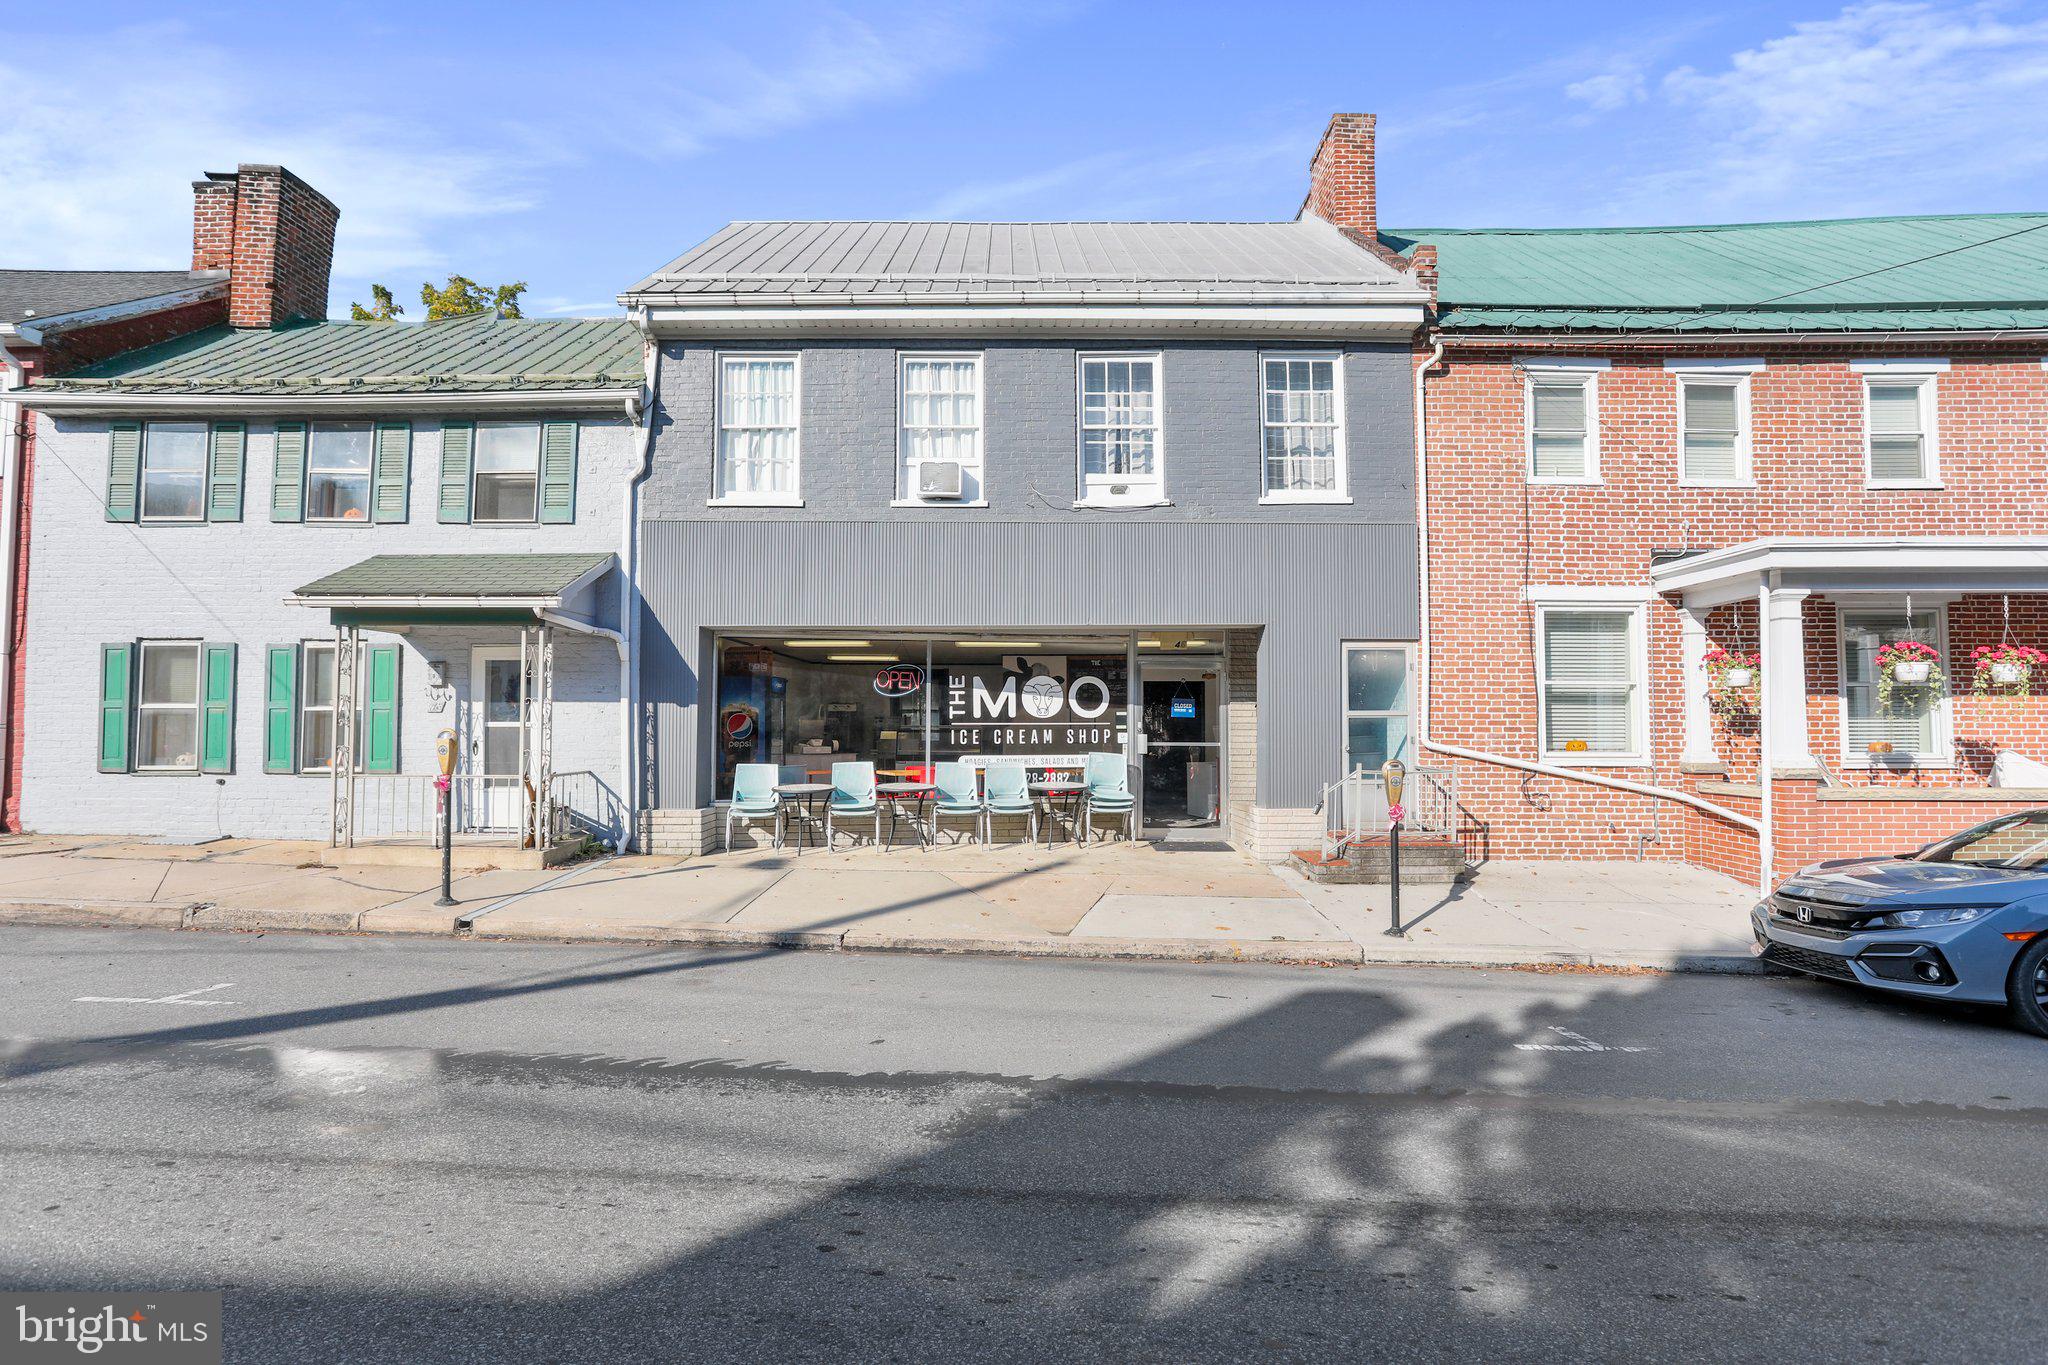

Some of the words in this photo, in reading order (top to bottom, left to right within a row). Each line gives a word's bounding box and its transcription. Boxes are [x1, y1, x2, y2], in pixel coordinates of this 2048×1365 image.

[876, 670, 920, 690] OPEN
[949, 675, 966, 720] THE
[728, 739, 752, 749] pepsi
[951, 729, 980, 745] ICE
[993, 729, 1053, 745] CREAM
[1066, 729, 1111, 744] SHOP
[1040, 757, 1065, 766] SALADS
